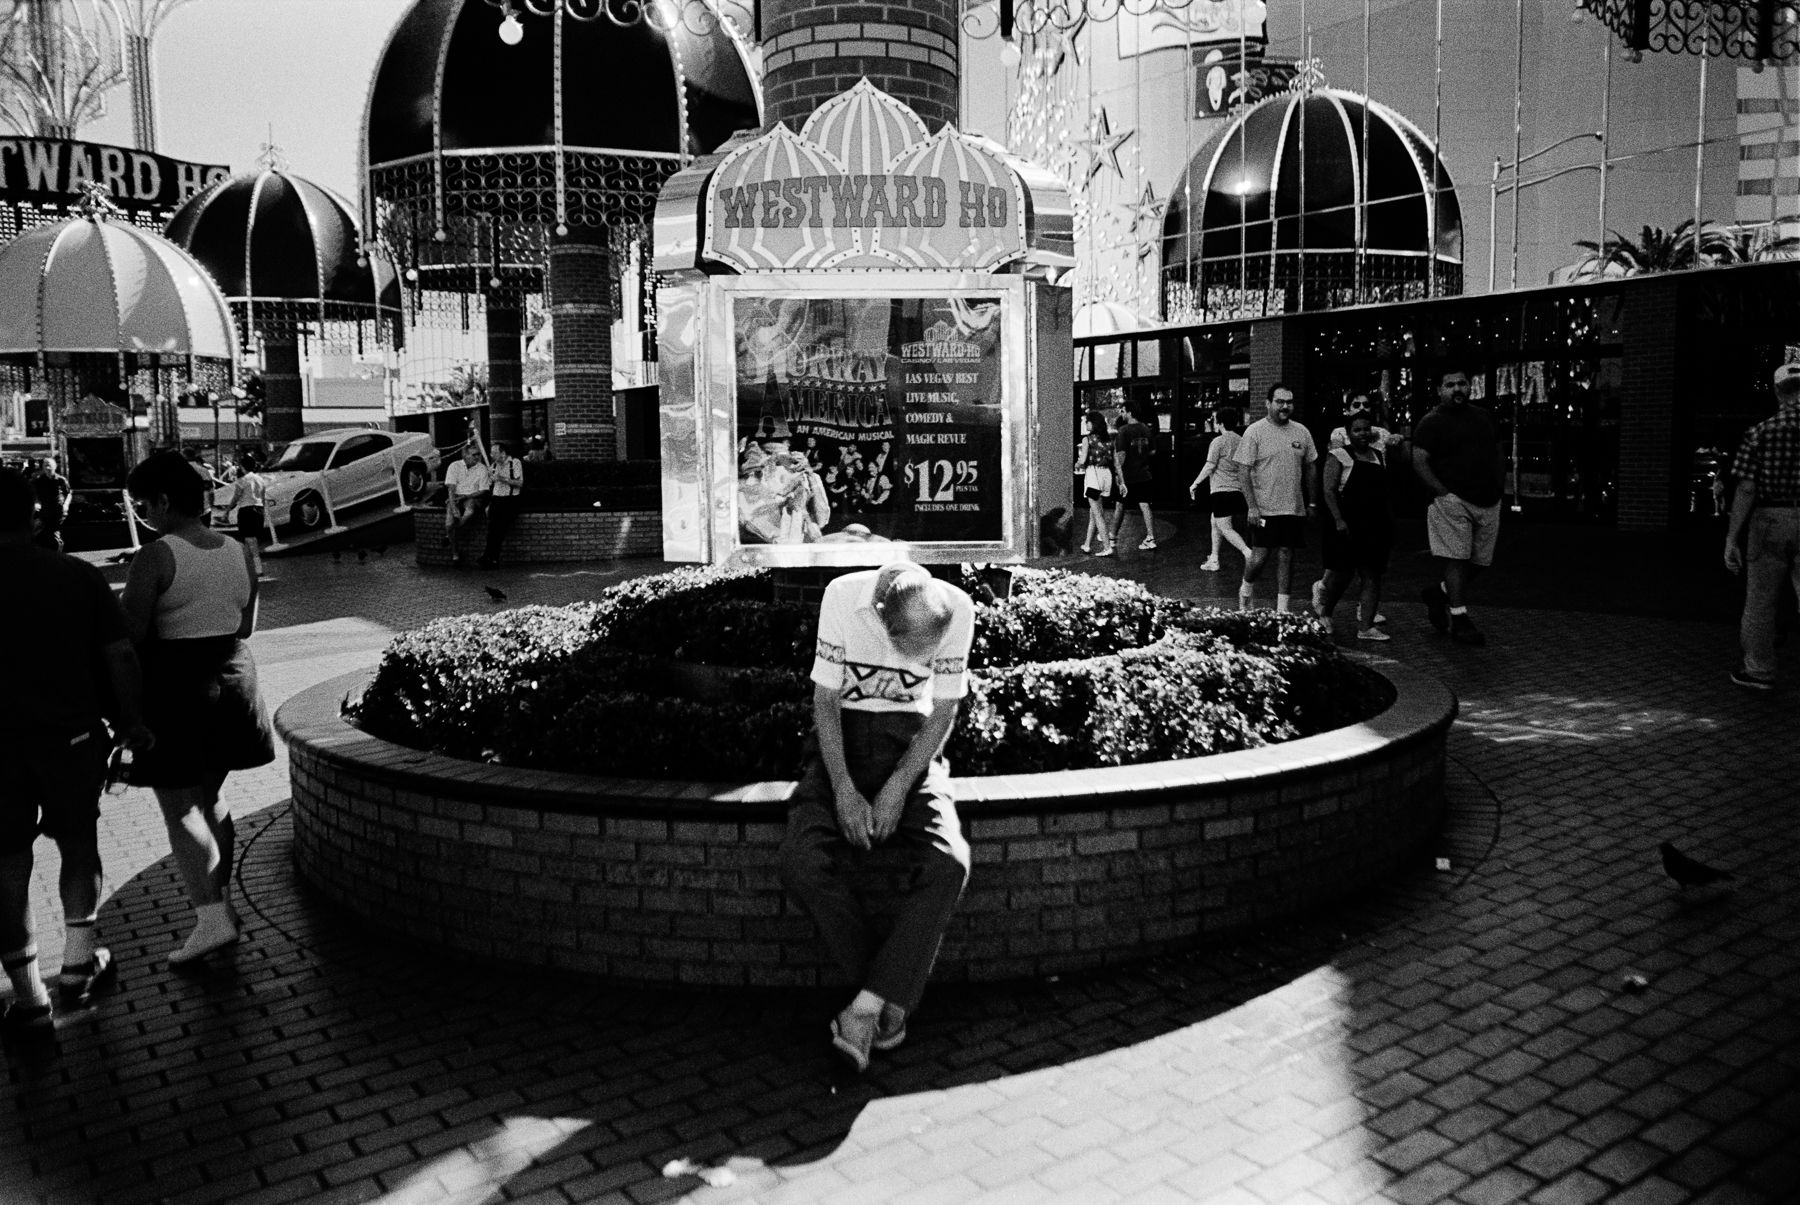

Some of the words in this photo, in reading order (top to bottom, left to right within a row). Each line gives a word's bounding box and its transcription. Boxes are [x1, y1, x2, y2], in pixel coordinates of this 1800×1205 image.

[720, 175, 947, 229] WESTWARD
[959, 180, 1007, 229] HO
[905, 372, 922, 384] LAS
[955, 372, 979, 384] BEST
[755, 364, 893, 438] AMERICA
[905, 392, 926, 403] LIVE
[905, 412, 944, 424] COMEDY
[946, 412, 954, 424] &
[796, 424, 810, 434] AN
[812, 426, 856, 441] AMERICAN
[858, 430, 895, 441] MUSICAL
[905, 433, 936, 445] MAGIC
[937, 433, 967, 445] REVUE
[914, 503, 945, 512] INCLUDES
[945, 503, 958, 512] ONE
[959, 503, 981, 512] DRINK
